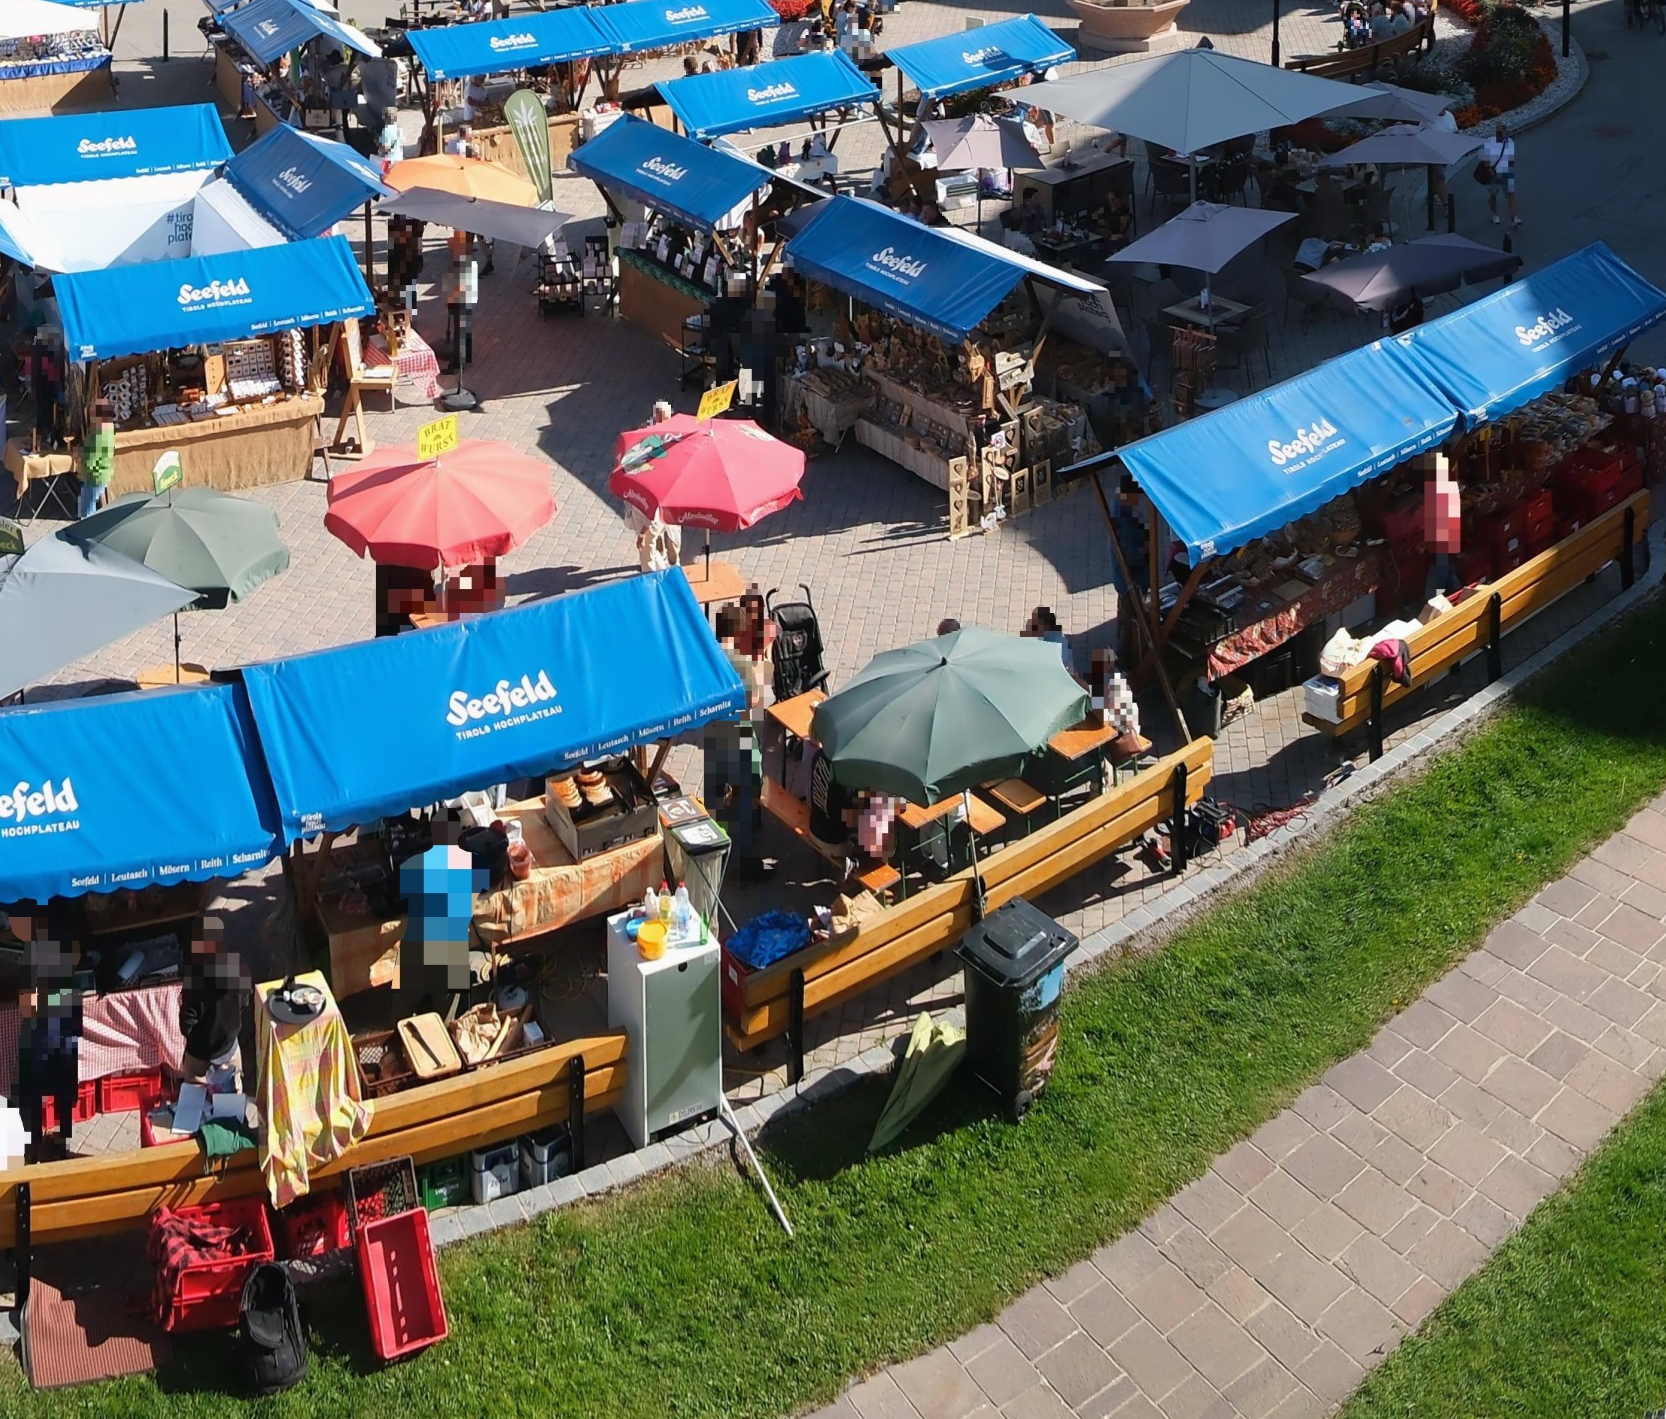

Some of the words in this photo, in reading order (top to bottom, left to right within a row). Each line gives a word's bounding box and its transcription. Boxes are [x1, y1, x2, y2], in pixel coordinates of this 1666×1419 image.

[490, 33, 536, 49] Seefeld
[747, 82, 795, 102] Seefeld
[76, 135, 136, 155] Seefeld
[642, 157, 692, 181] Seefeld
[166, 211, 194, 225] #tiro
[872, 246, 929, 279] Seefeld
[177, 276, 251, 305] Seefeld
[1513, 308, 1573, 346] Seefeld
[423, 420, 453, 438] BRAT
[1267, 417, 1338, 466] Seefeld
[419, 433, 456, 454] WURST
[445, 668, 558, 727] Seefeld
[455, 726, 491, 742] TIROLS
[493, 704, 563, 731] HOCHPLATEAU
[563, 746, 589, 762] Seefeld
[597, 734, 630, 751] Leutasch
[638, 722, 665, 738] Mösern
[672, 712, 692, 728] Reith
[699, 700, 732, 718] Scharnitz
[0, 819, 80, 837] HOCHPLATEAU
[71, 875, 100, 888] Seefeld
[110, 867, 148, 883] Leutasch
[159, 862, 190, 876] Mösern
[200, 855, 223, 869] Reith
